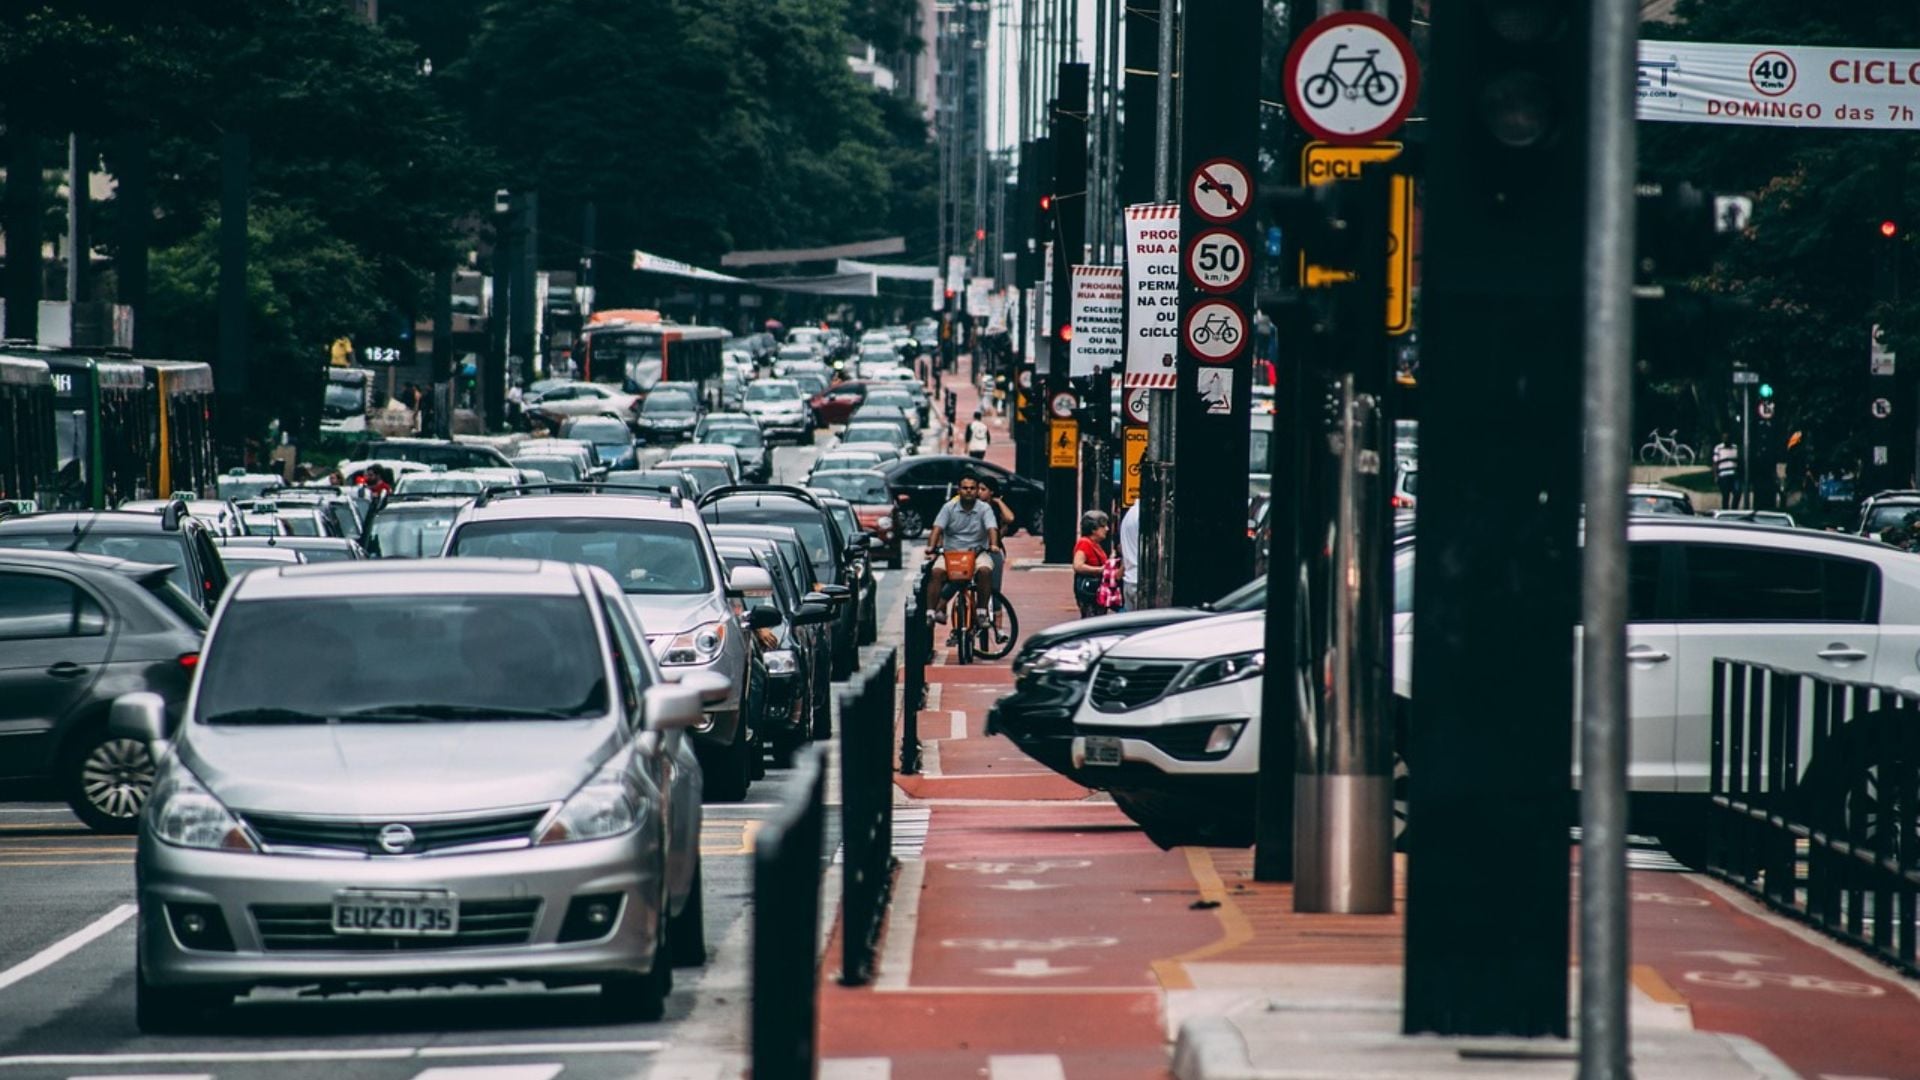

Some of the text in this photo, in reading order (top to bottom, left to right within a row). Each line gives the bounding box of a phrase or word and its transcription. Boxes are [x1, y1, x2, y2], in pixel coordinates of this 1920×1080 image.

[1755, 60, 1788, 79] 40
[1708, 99, 1913, 121] DOMINGO das 7h
[1137, 244, 1164, 253] RUA
[1199, 243, 1240, 271] 50
[1204, 273, 1230, 282] km/h
[1137, 296, 1156, 306] NA
[1156, 312, 1175, 322] OU
